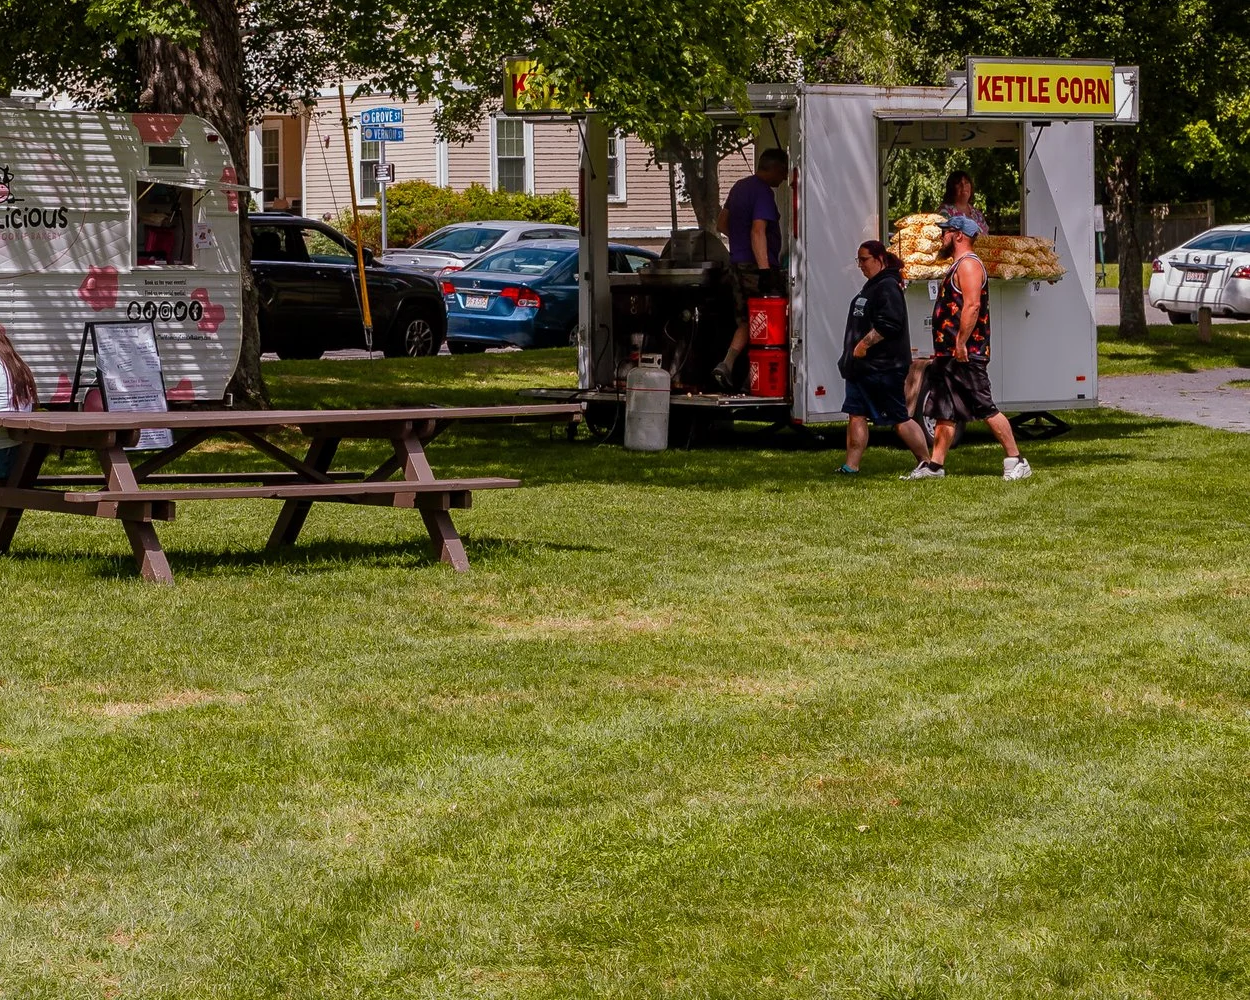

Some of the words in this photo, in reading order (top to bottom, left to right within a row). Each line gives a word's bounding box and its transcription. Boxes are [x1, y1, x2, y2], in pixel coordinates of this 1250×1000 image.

[977, 76, 1050, 103] KETTLE
[1056, 77, 1110, 105] CORN
[371, 111, 393, 123] GROVE
[395, 112, 400, 120] ST
[374, 129, 397, 140] VERNON
[31, 232, 62, 240] BAKERY
